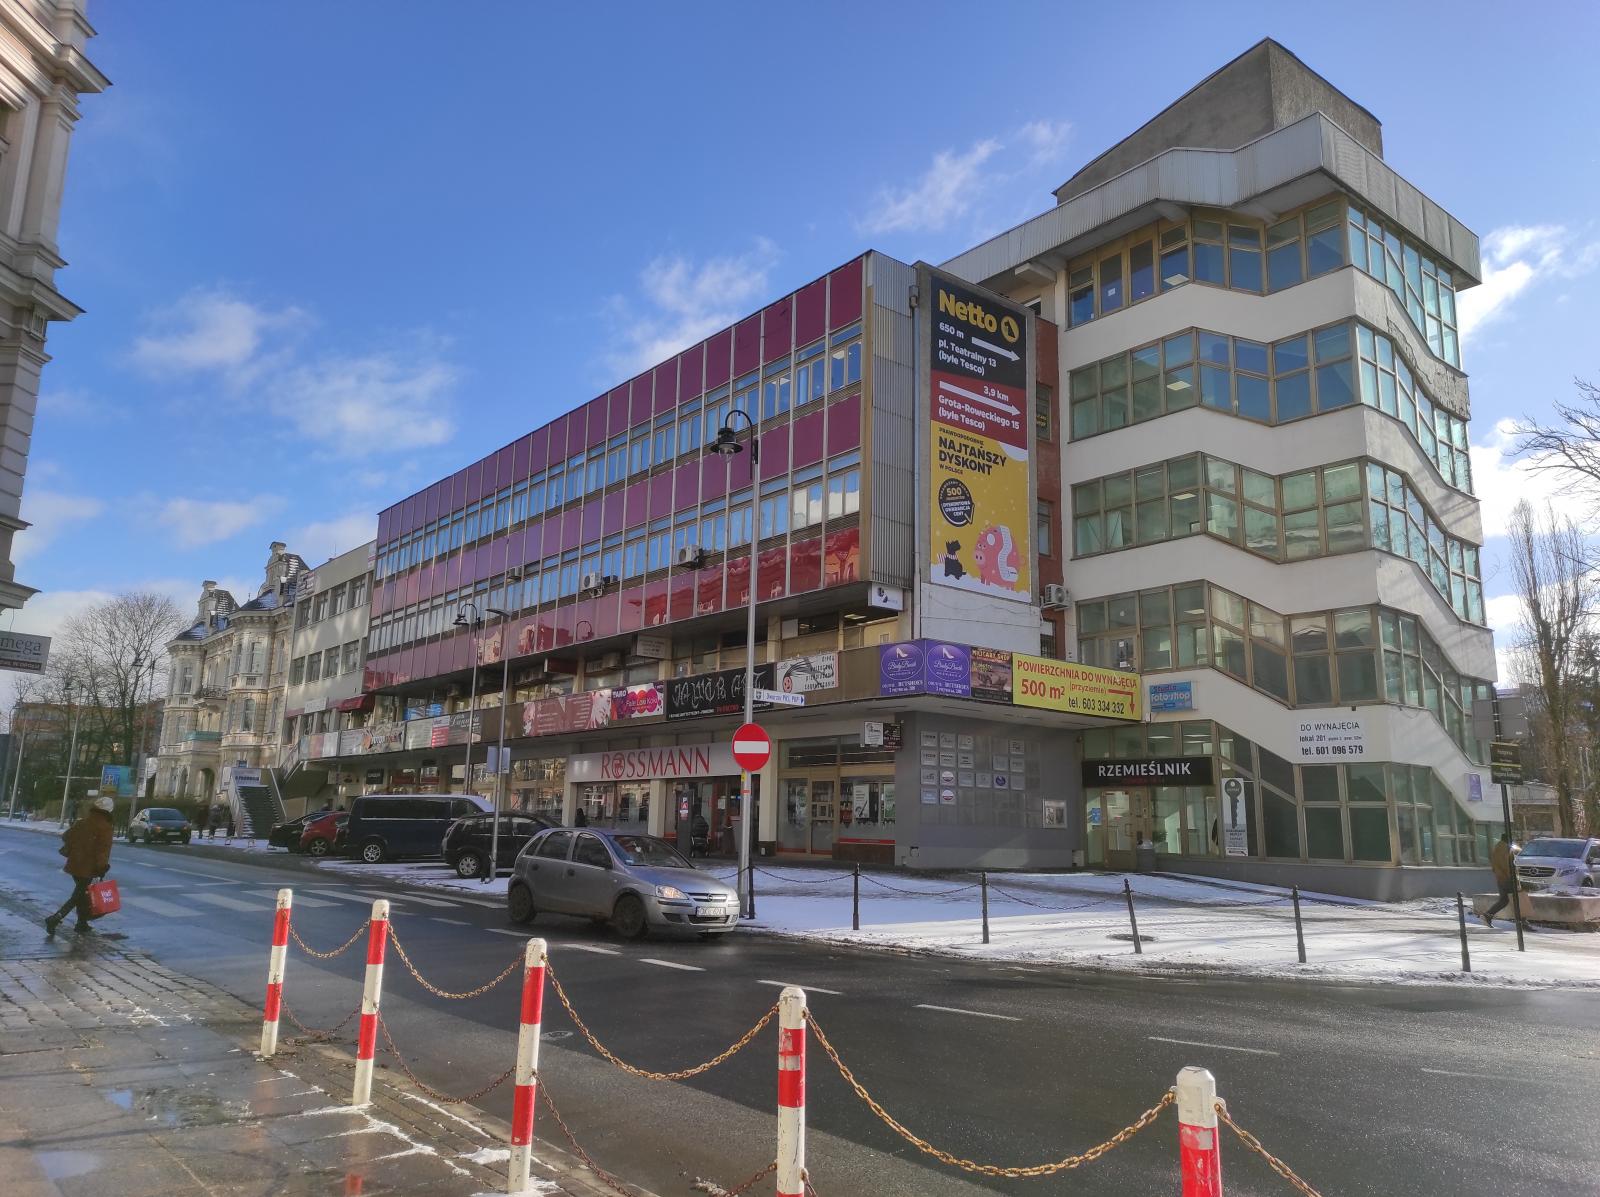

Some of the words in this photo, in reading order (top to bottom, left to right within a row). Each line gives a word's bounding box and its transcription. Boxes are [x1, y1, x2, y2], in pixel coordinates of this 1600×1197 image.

[939, 289, 997, 332] Netto
[940, 322, 955, 335] 650
[956, 330, 964, 339] m
[938, 339, 948, 350] pl.
[951, 342, 986, 364] Teatralny
[988, 358, 996, 368] 13
[938, 352, 959, 366] (byłe
[960, 358, 984, 376] Tesco)
[984, 386, 995, 397] 3,9
[997, 390, 1008, 401] km
[938, 395, 1010, 428] Grota-Roweckiego
[1012, 420, 1020, 429] 15
[938, 407, 959, 421] (byłe
[960, 412, 985, 431] Tesco)
[939, 436, 1007, 466] NAJTAŃSZY
[939, 451, 992, 475] DYSKONT
[946, 488, 962, 496] 500
[1018, 660, 1079, 680] POWIERZCHNIA
[1081, 671, 1094, 682] DO
[1095, 674, 1137, 688] WYNAJĘCIA
[1021, 679, 1046, 697] 500
[1069, 697, 1080, 708] tel.
[1083, 698, 1095, 710] 603
[1098, 700, 1110, 712] 334
[1112, 702, 1124, 714] 332
[1315, 722, 1360, 731] WYNAJĘCIA
[1302, 747, 1313, 755] tel.
[1316, 746, 1329, 755] 601
[1332, 746, 1346, 754] 096
[1349, 745, 1363, 754] 579
[601, 746, 710, 780] ROSSMANN
[1098, 760, 1191, 777] RZEMIEŚLNIK
